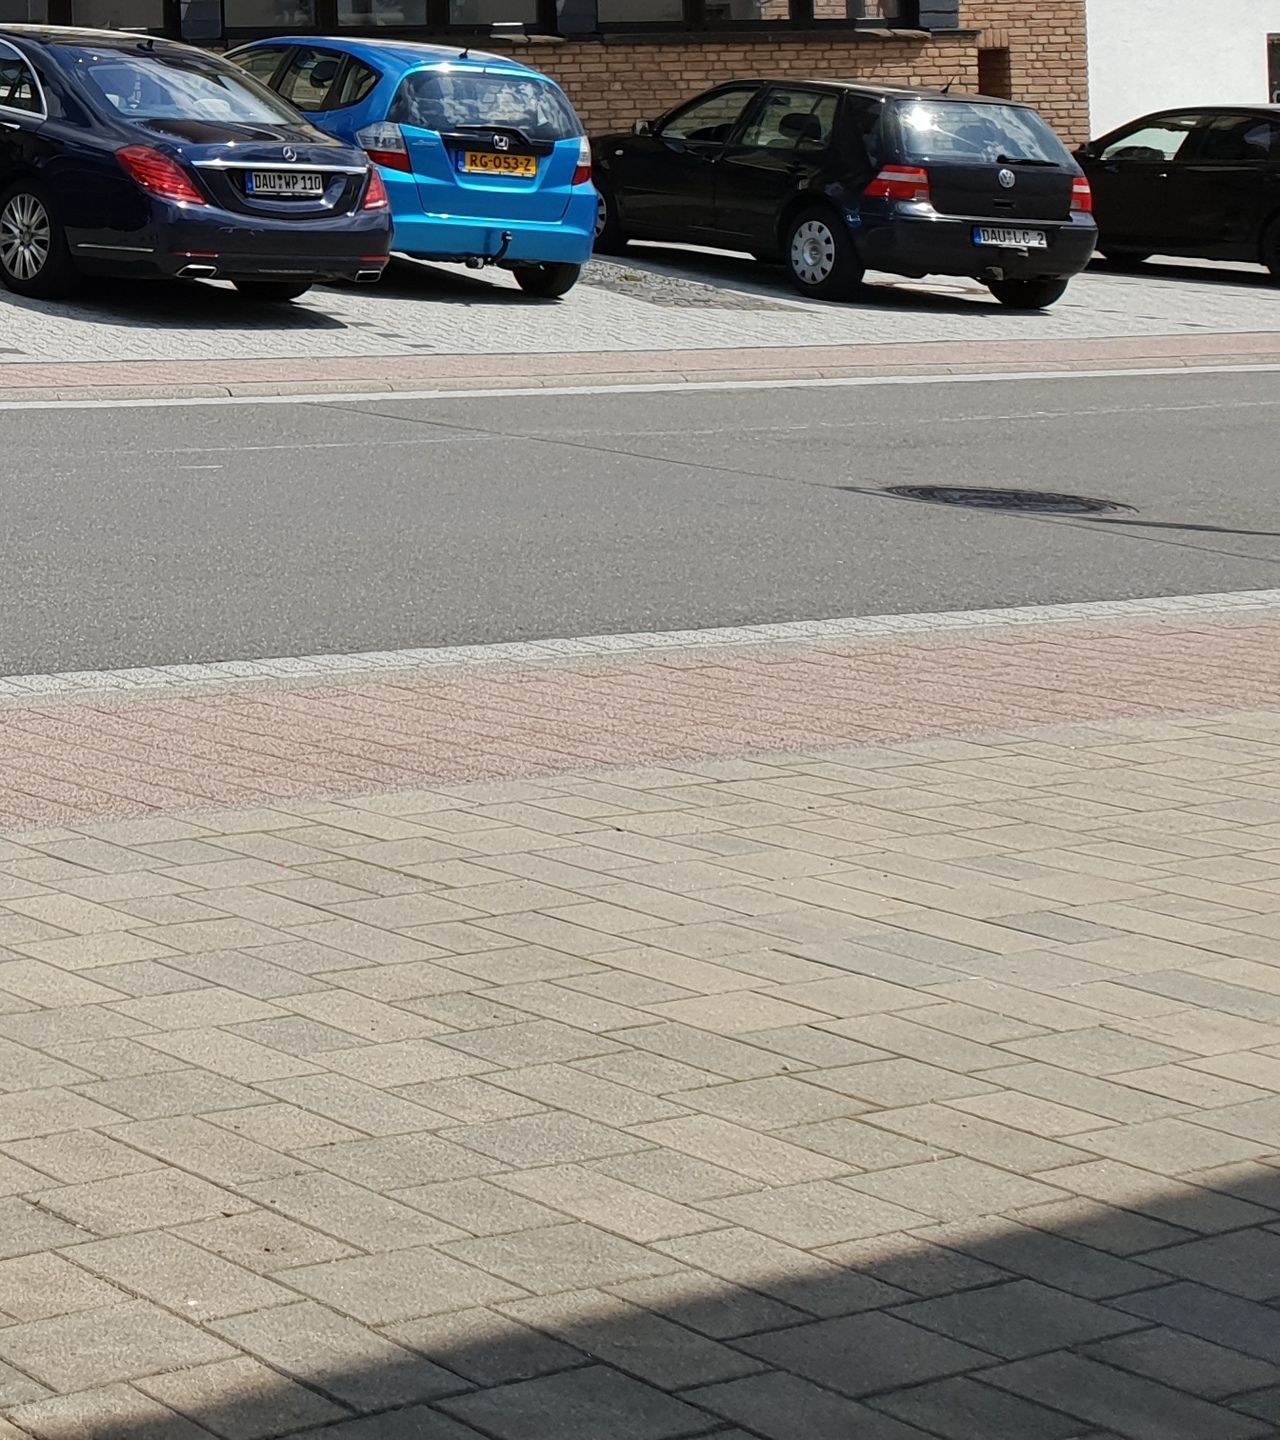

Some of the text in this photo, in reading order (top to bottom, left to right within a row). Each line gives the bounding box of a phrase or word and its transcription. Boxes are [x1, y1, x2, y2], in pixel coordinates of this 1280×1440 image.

[470, 153, 532, 172] RG-053-Z
[254, 174, 321, 190] DAU WP 110
[982, 229, 1006, 242] DAU
[1037, 232, 1045, 245] 2
